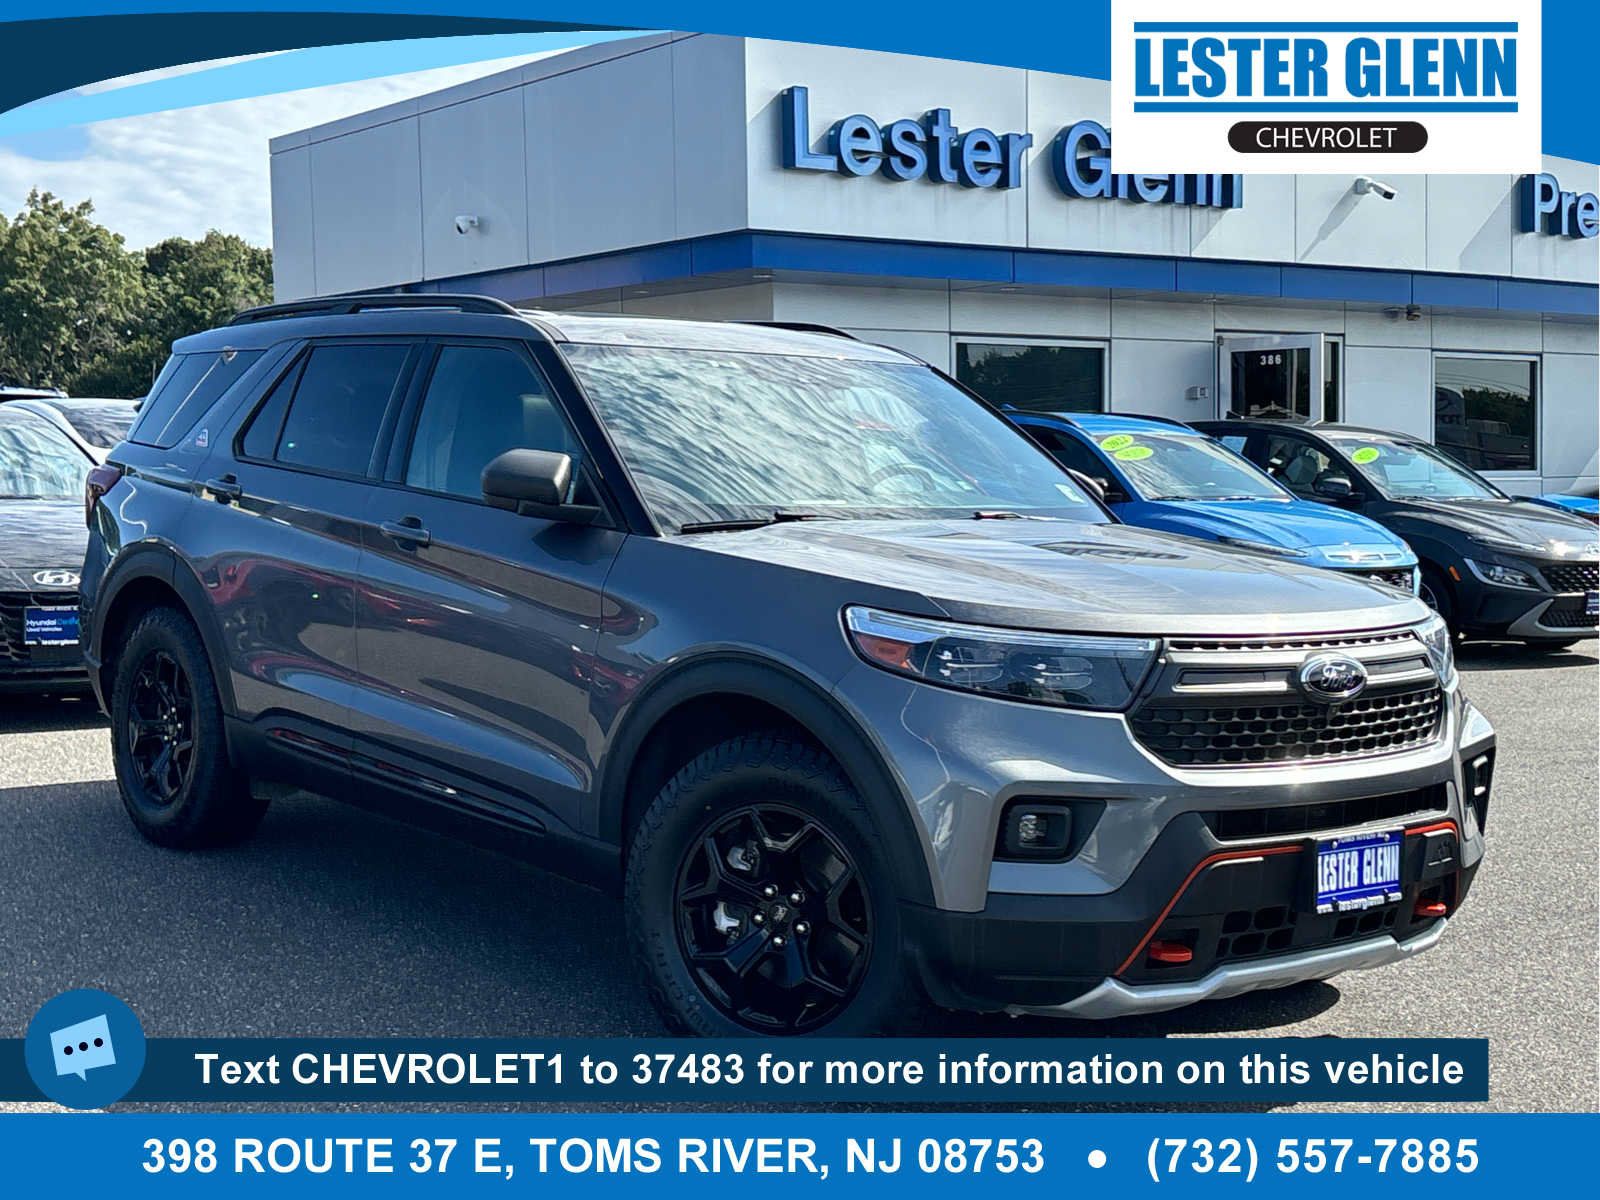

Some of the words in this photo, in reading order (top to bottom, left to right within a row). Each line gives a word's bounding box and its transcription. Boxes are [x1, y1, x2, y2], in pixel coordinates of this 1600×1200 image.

[783, 86, 1032, 189] Lester
[1520, 172, 1600, 239] Pre
[1259, 354, 1282, 366] 386
[1321, 663, 1356, 689] Ford
[1317, 850, 1359, 893] LESTER
[1362, 844, 1400, 886] GLENN
